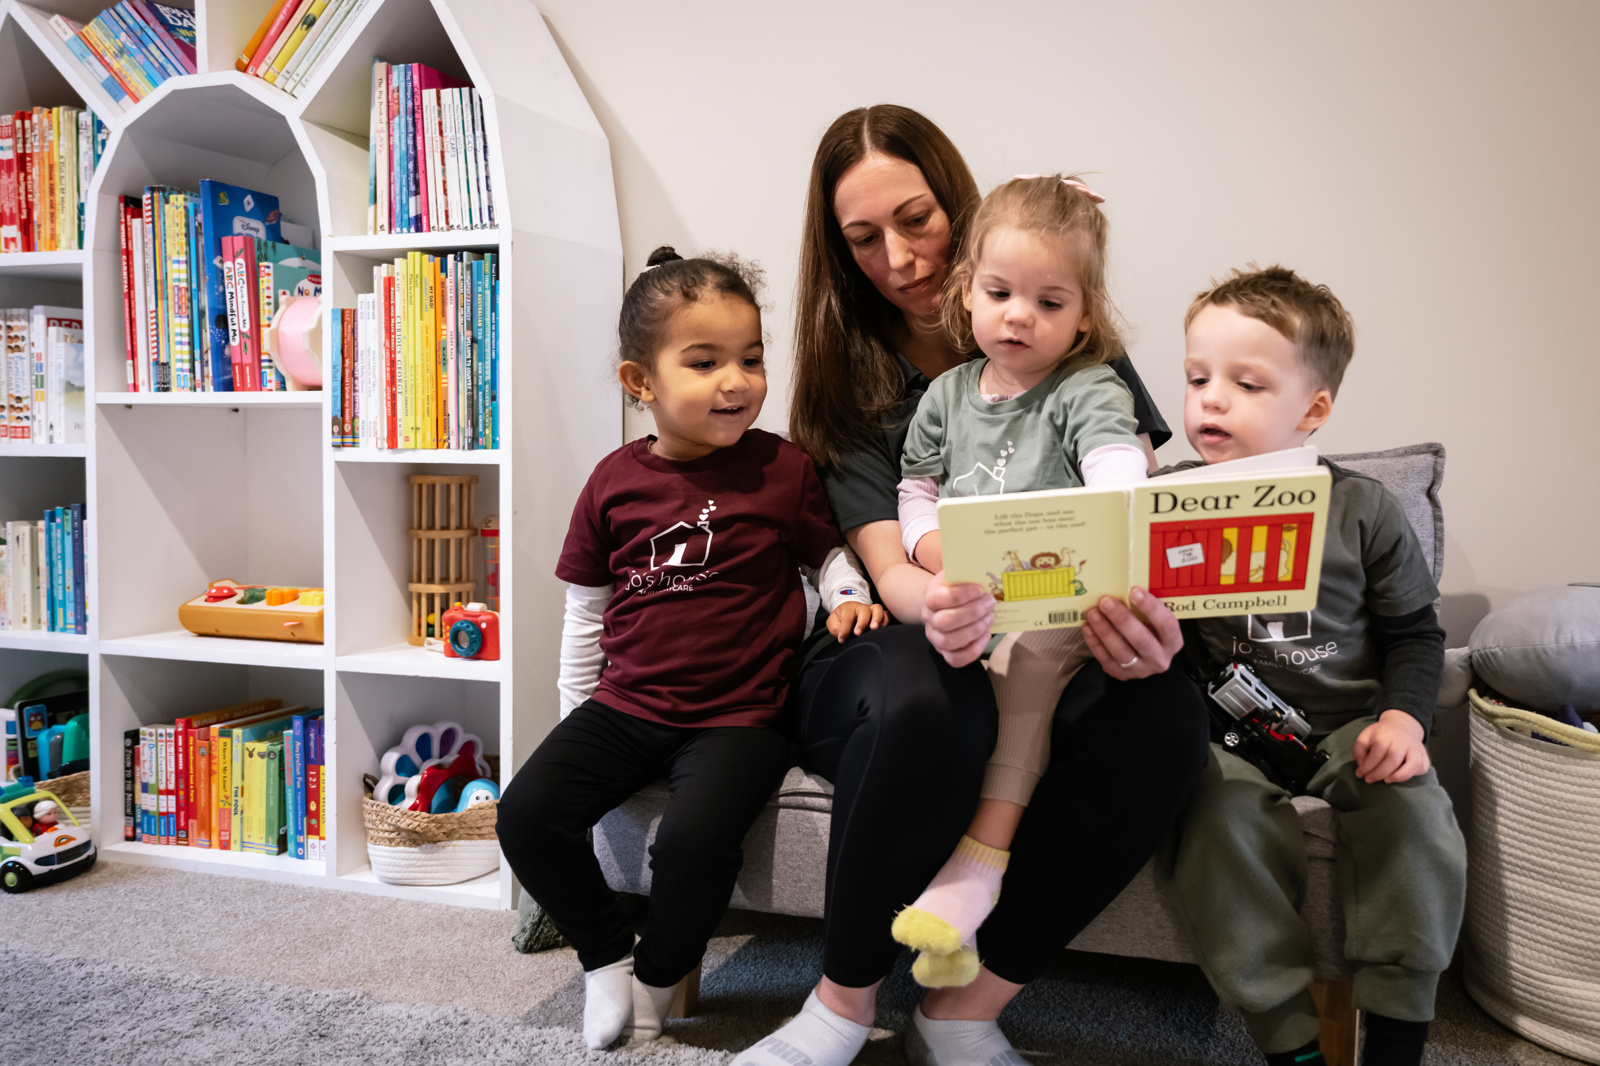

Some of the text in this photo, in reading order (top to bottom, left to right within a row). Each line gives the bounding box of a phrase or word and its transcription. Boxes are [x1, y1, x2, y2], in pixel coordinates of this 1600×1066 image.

[239, 219, 260, 234] Disney
[237, 262, 248, 329] ABC Me
[429, 286, 433, 294] MY
[226, 266, 238, 343] ABC Mindful Me
[332, 364, 340, 384] What
[1150, 485, 1316, 514] Dear Zoo
[1163, 595, 1287, 612] Rod Campbell
[1274, 641, 1338, 665] house
[284, 735, 293, 786] KANGAROO
[294, 740, 302, 775] Australian
[126, 769, 132, 778] TO
[223, 766, 228, 774] Mr
